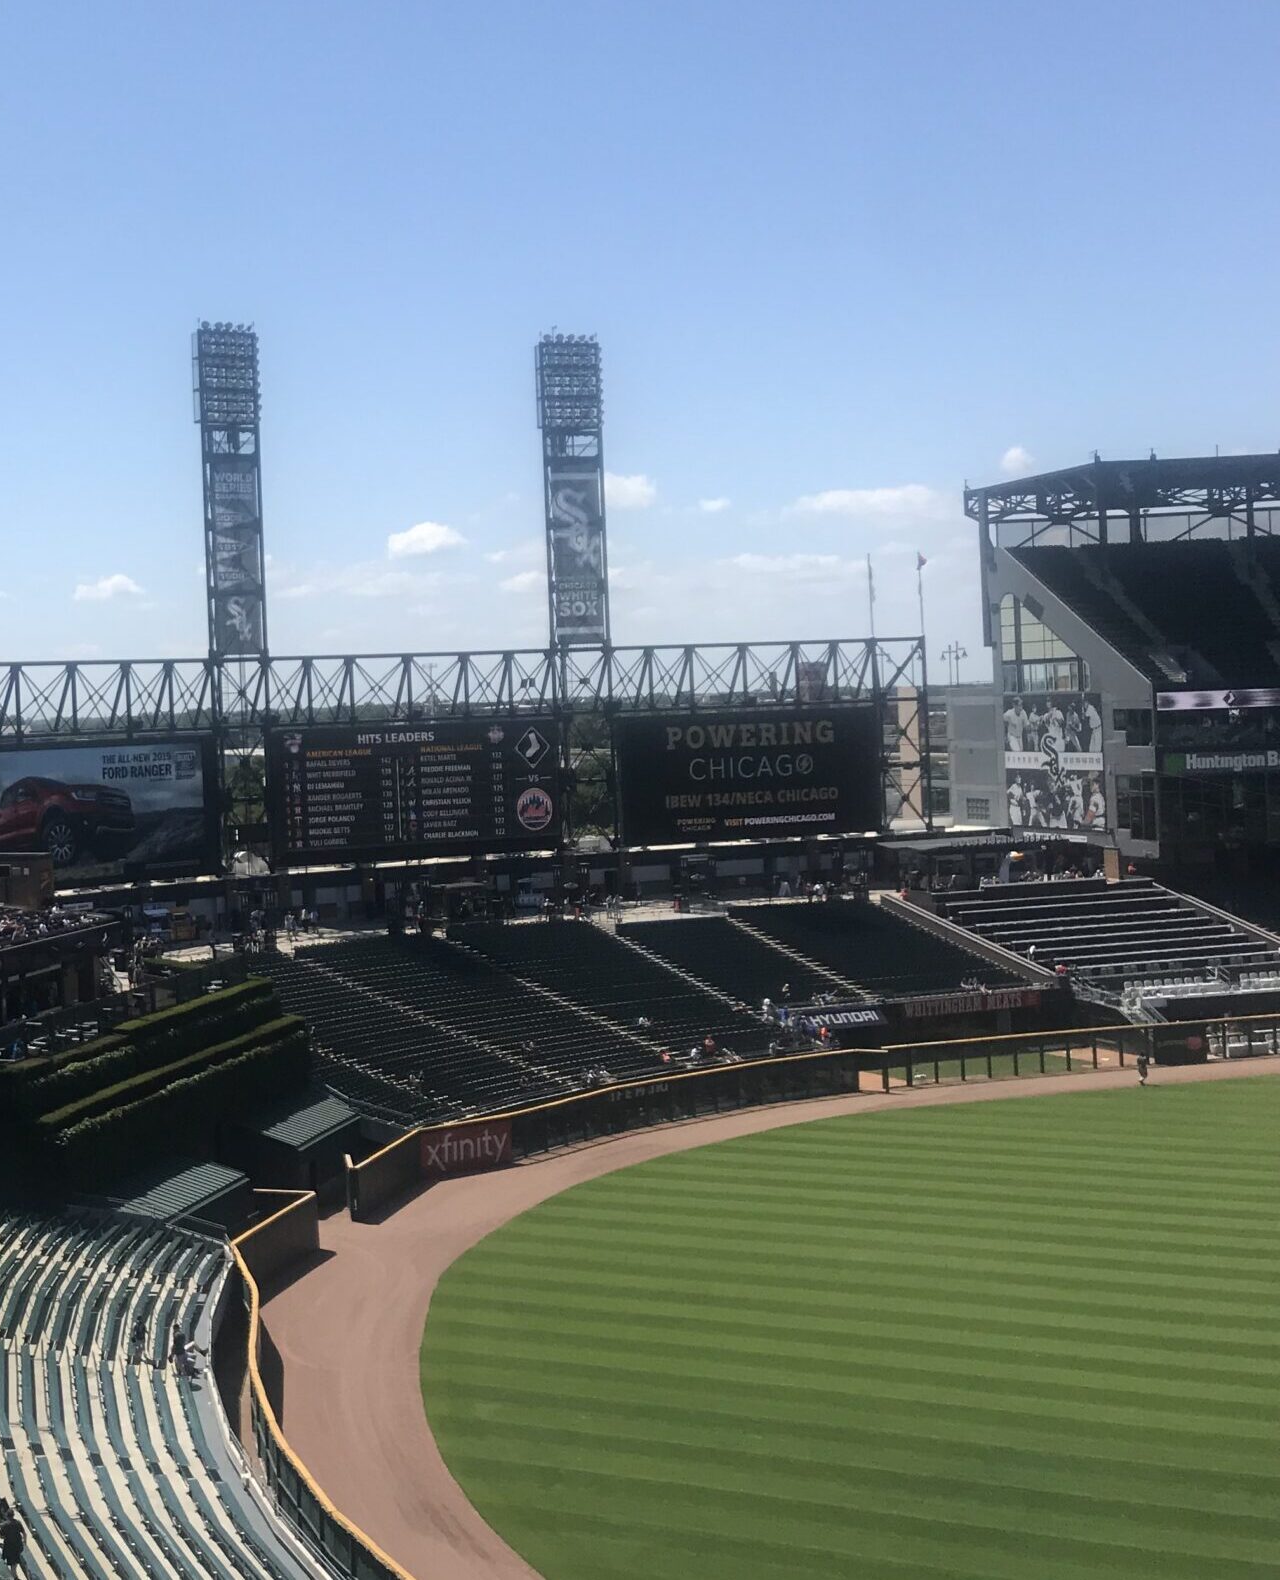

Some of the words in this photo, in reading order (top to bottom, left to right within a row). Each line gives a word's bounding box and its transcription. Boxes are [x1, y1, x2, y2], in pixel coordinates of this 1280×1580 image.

[214, 471, 252, 482] WORLD
[215, 482, 253, 493] SERIES
[559, 590, 598, 601] WHITE
[559, 601, 598, 617] SOX
[357, 733, 383, 745] HITS
[385, 731, 435, 744] LEADERS
[666, 720, 835, 750] POWERING
[102, 754, 116, 764] THE
[306, 749, 344, 758] AMERICAN
[1186, 752, 1266, 772] Huntington
[1267, 750, 1280, 768] B
[102, 766, 128, 779] FORD
[130, 763, 172, 778] RANGER
[665, 795, 701, 809] IBEW
[777, 787, 839, 803] CHICAGO
[724, 818, 743, 827] VISIT
[744, 812, 836, 826] POWERINGCHICAGO.COM
[904, 995, 983, 1017] WHITTINGHAM
[986, 991, 1023, 1010] MEATS
[808, 1009, 880, 1027] HYUNDAI
[427, 1128, 508, 1171] xfinity
